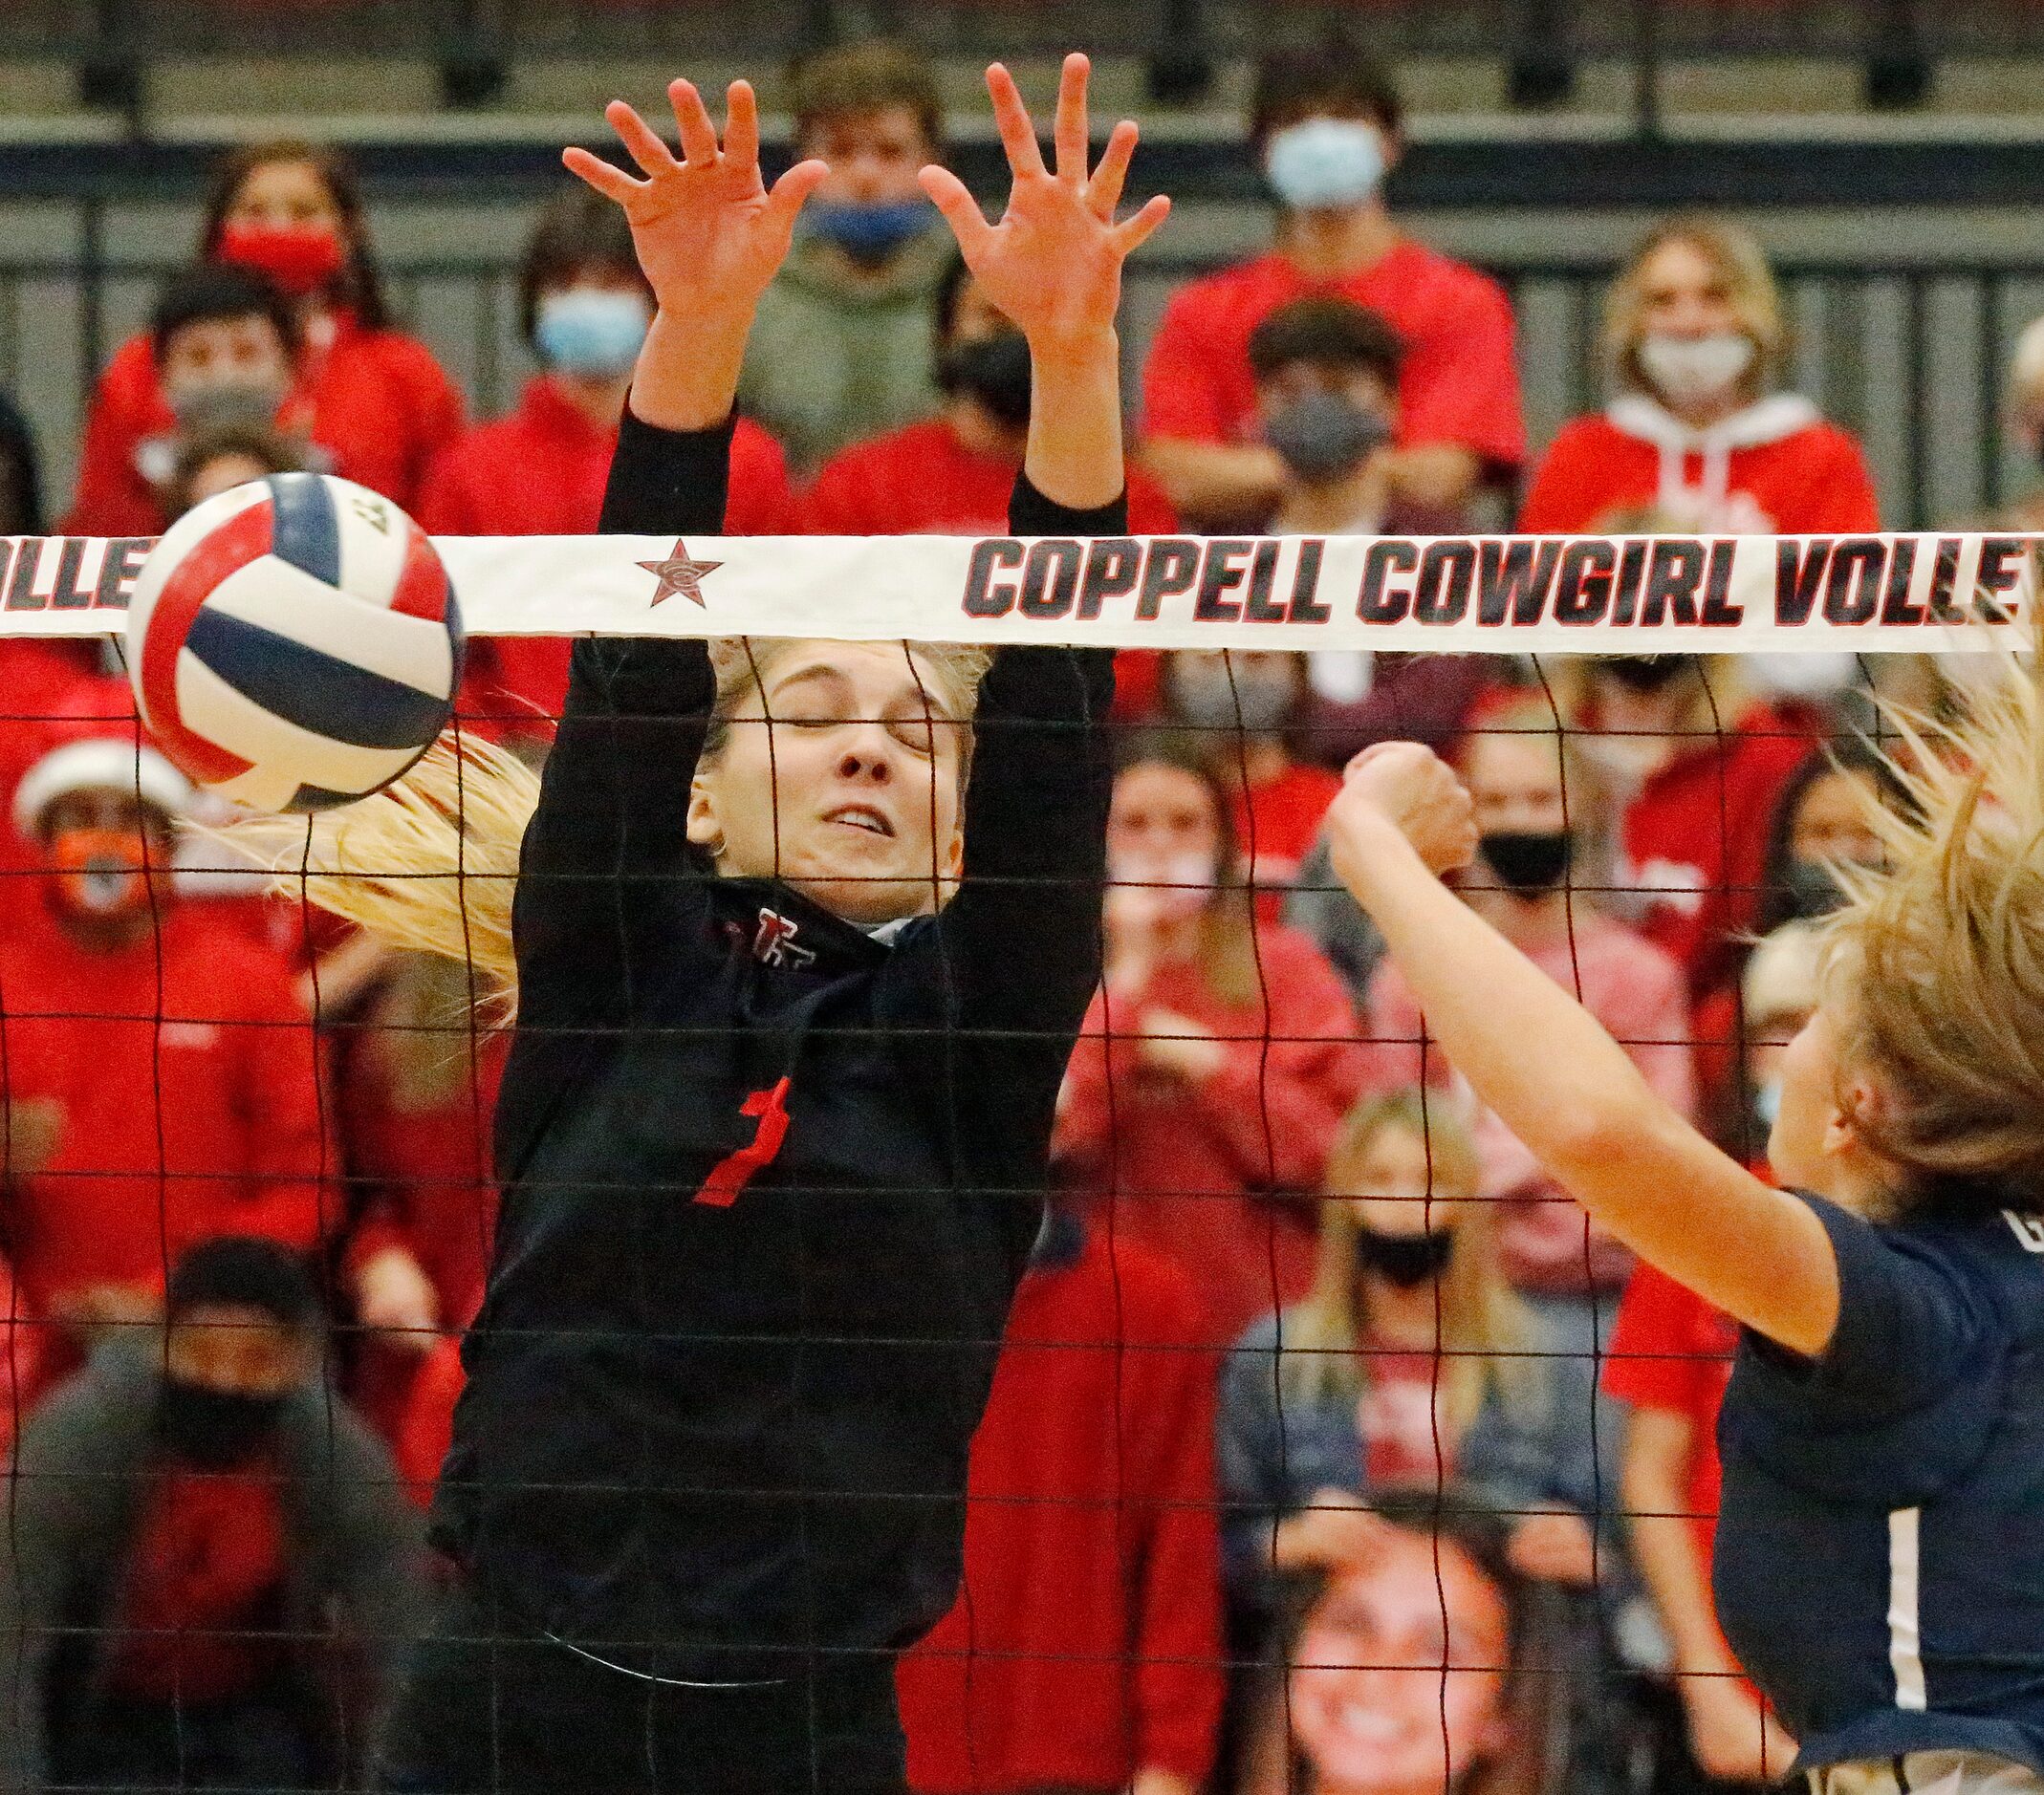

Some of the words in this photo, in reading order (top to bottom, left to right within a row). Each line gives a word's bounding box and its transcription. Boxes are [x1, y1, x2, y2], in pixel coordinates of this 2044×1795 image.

[961, 538, 1333, 625] COPPELL
[1355, 539, 1744, 628] COWGIRL
[1887, 1505, 1927, 1711] 1
